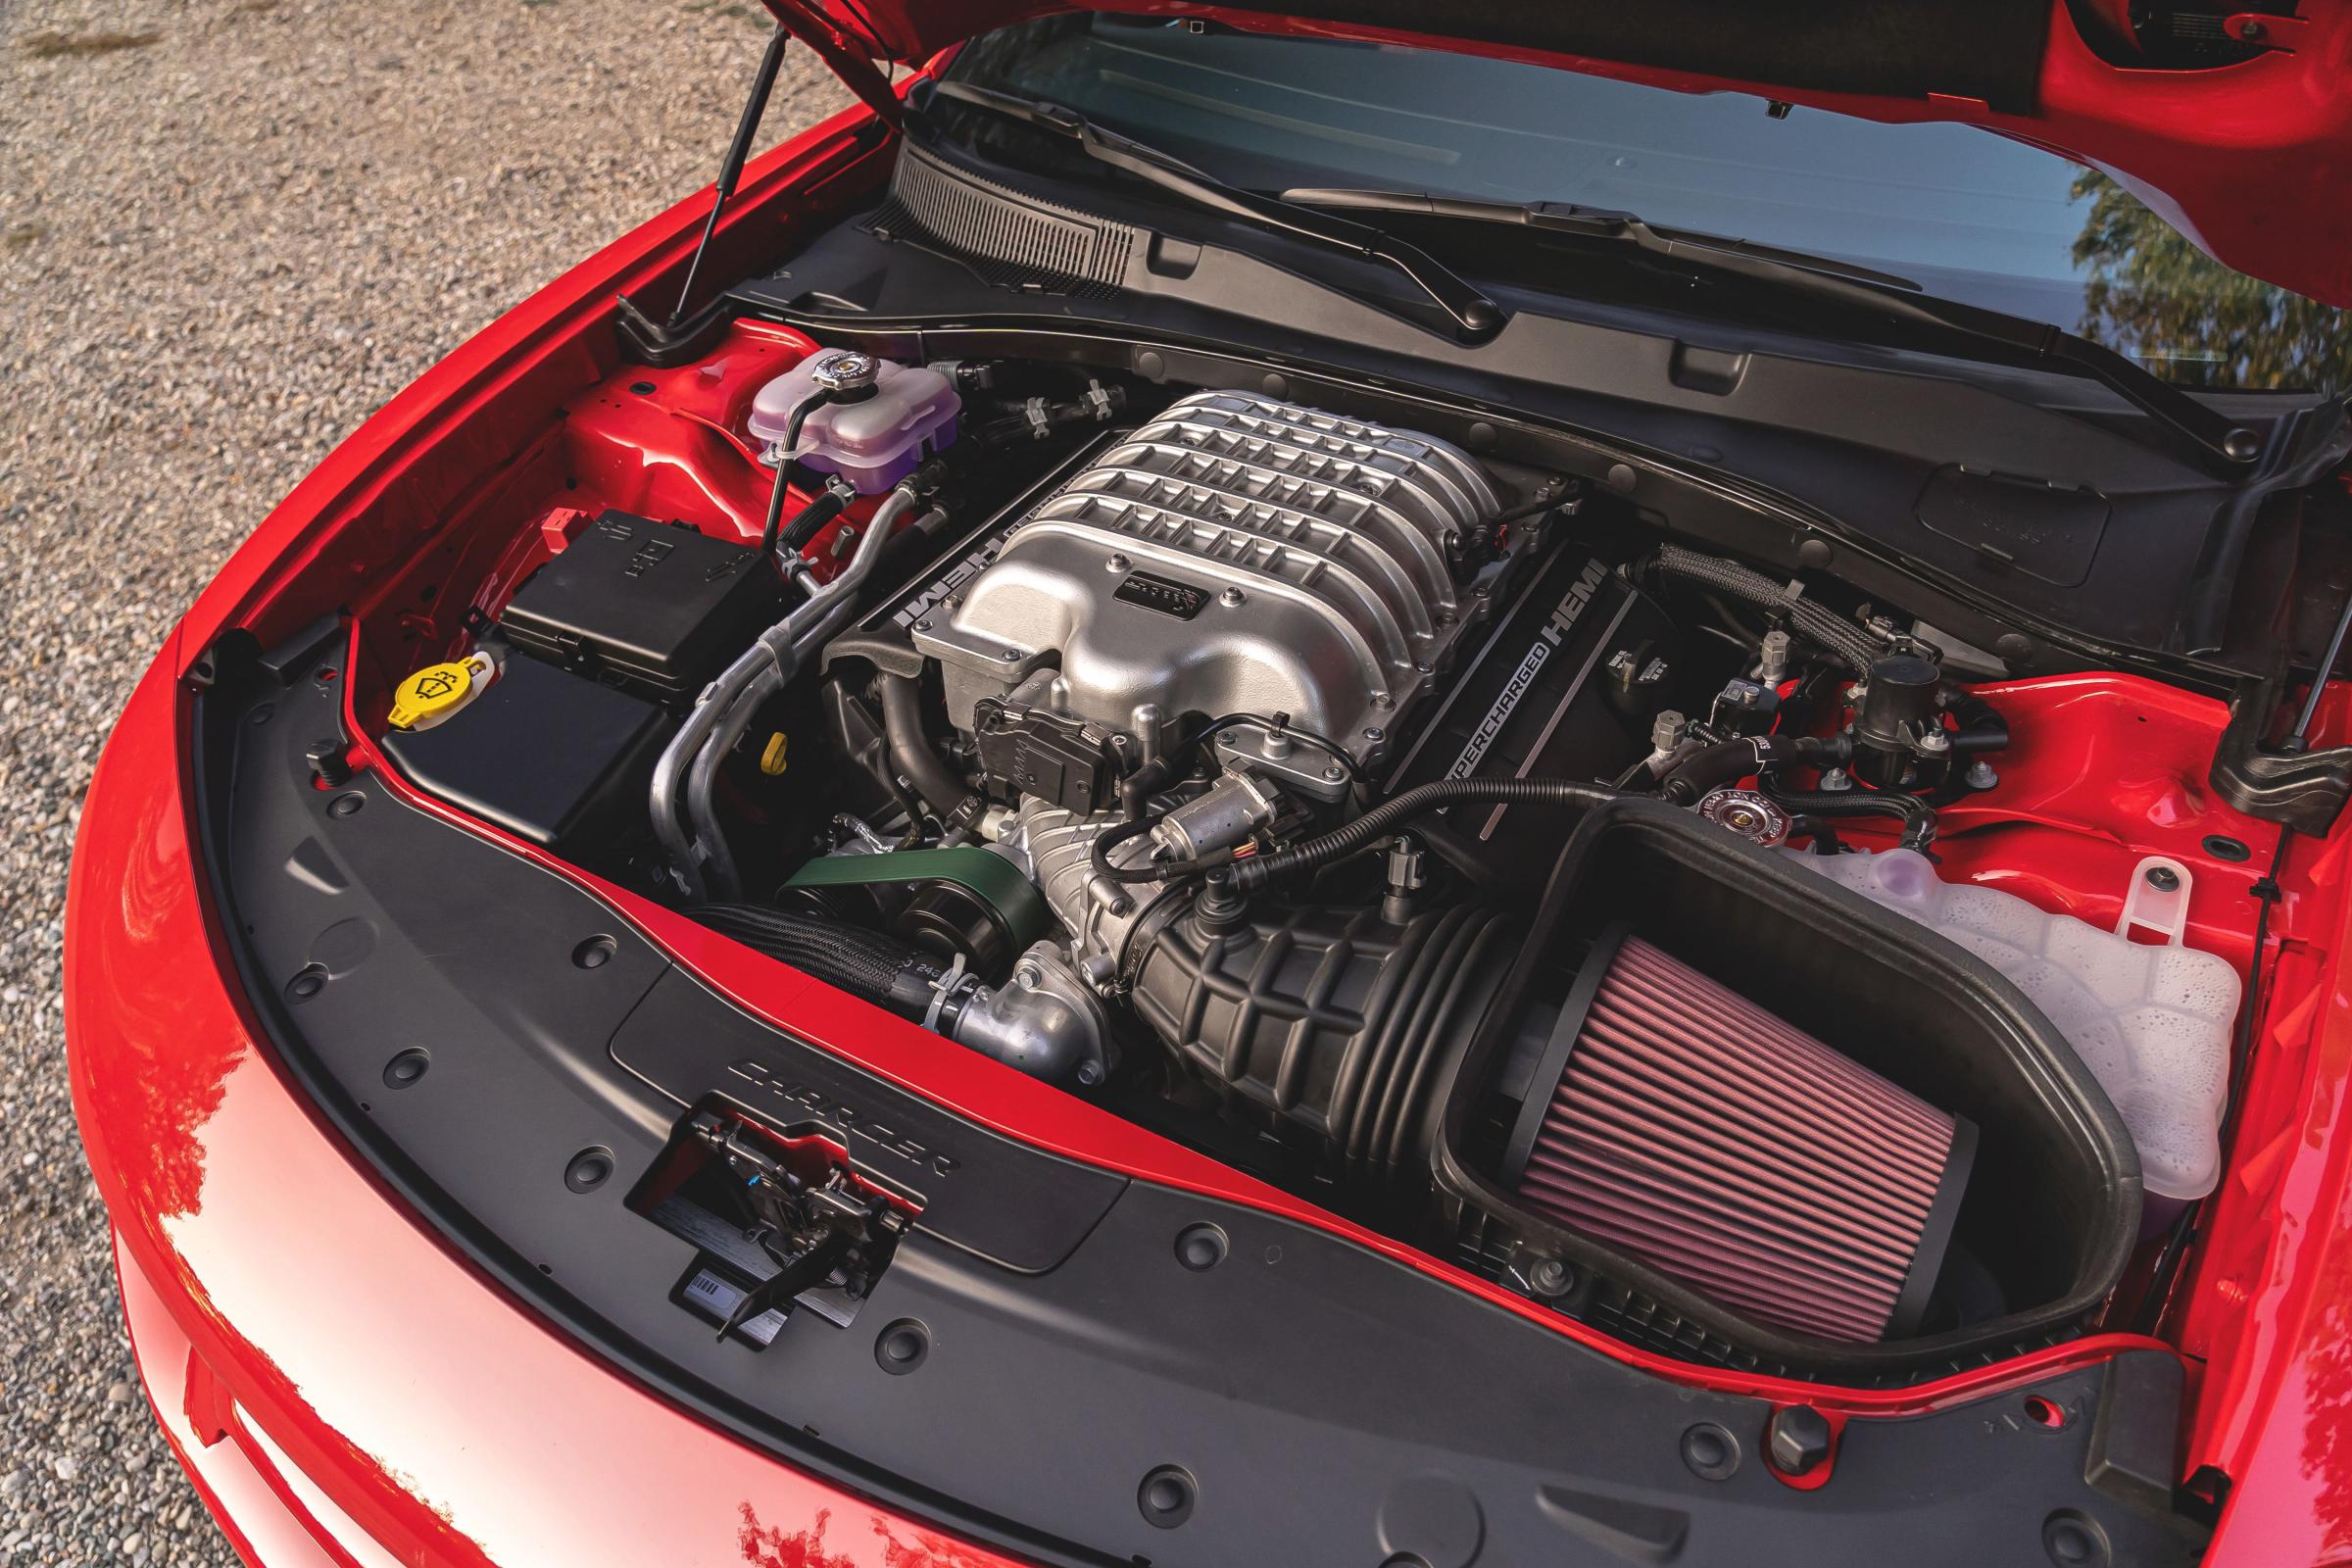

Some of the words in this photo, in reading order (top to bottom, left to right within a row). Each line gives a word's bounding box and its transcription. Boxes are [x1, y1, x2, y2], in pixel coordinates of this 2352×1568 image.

[893, 538, 1004, 628] HEMI
[1445, 642, 1549, 781] PERCHARGED
[1541, 558, 1608, 647] HEMI
[728, 1058, 960, 1177] CHARGER
